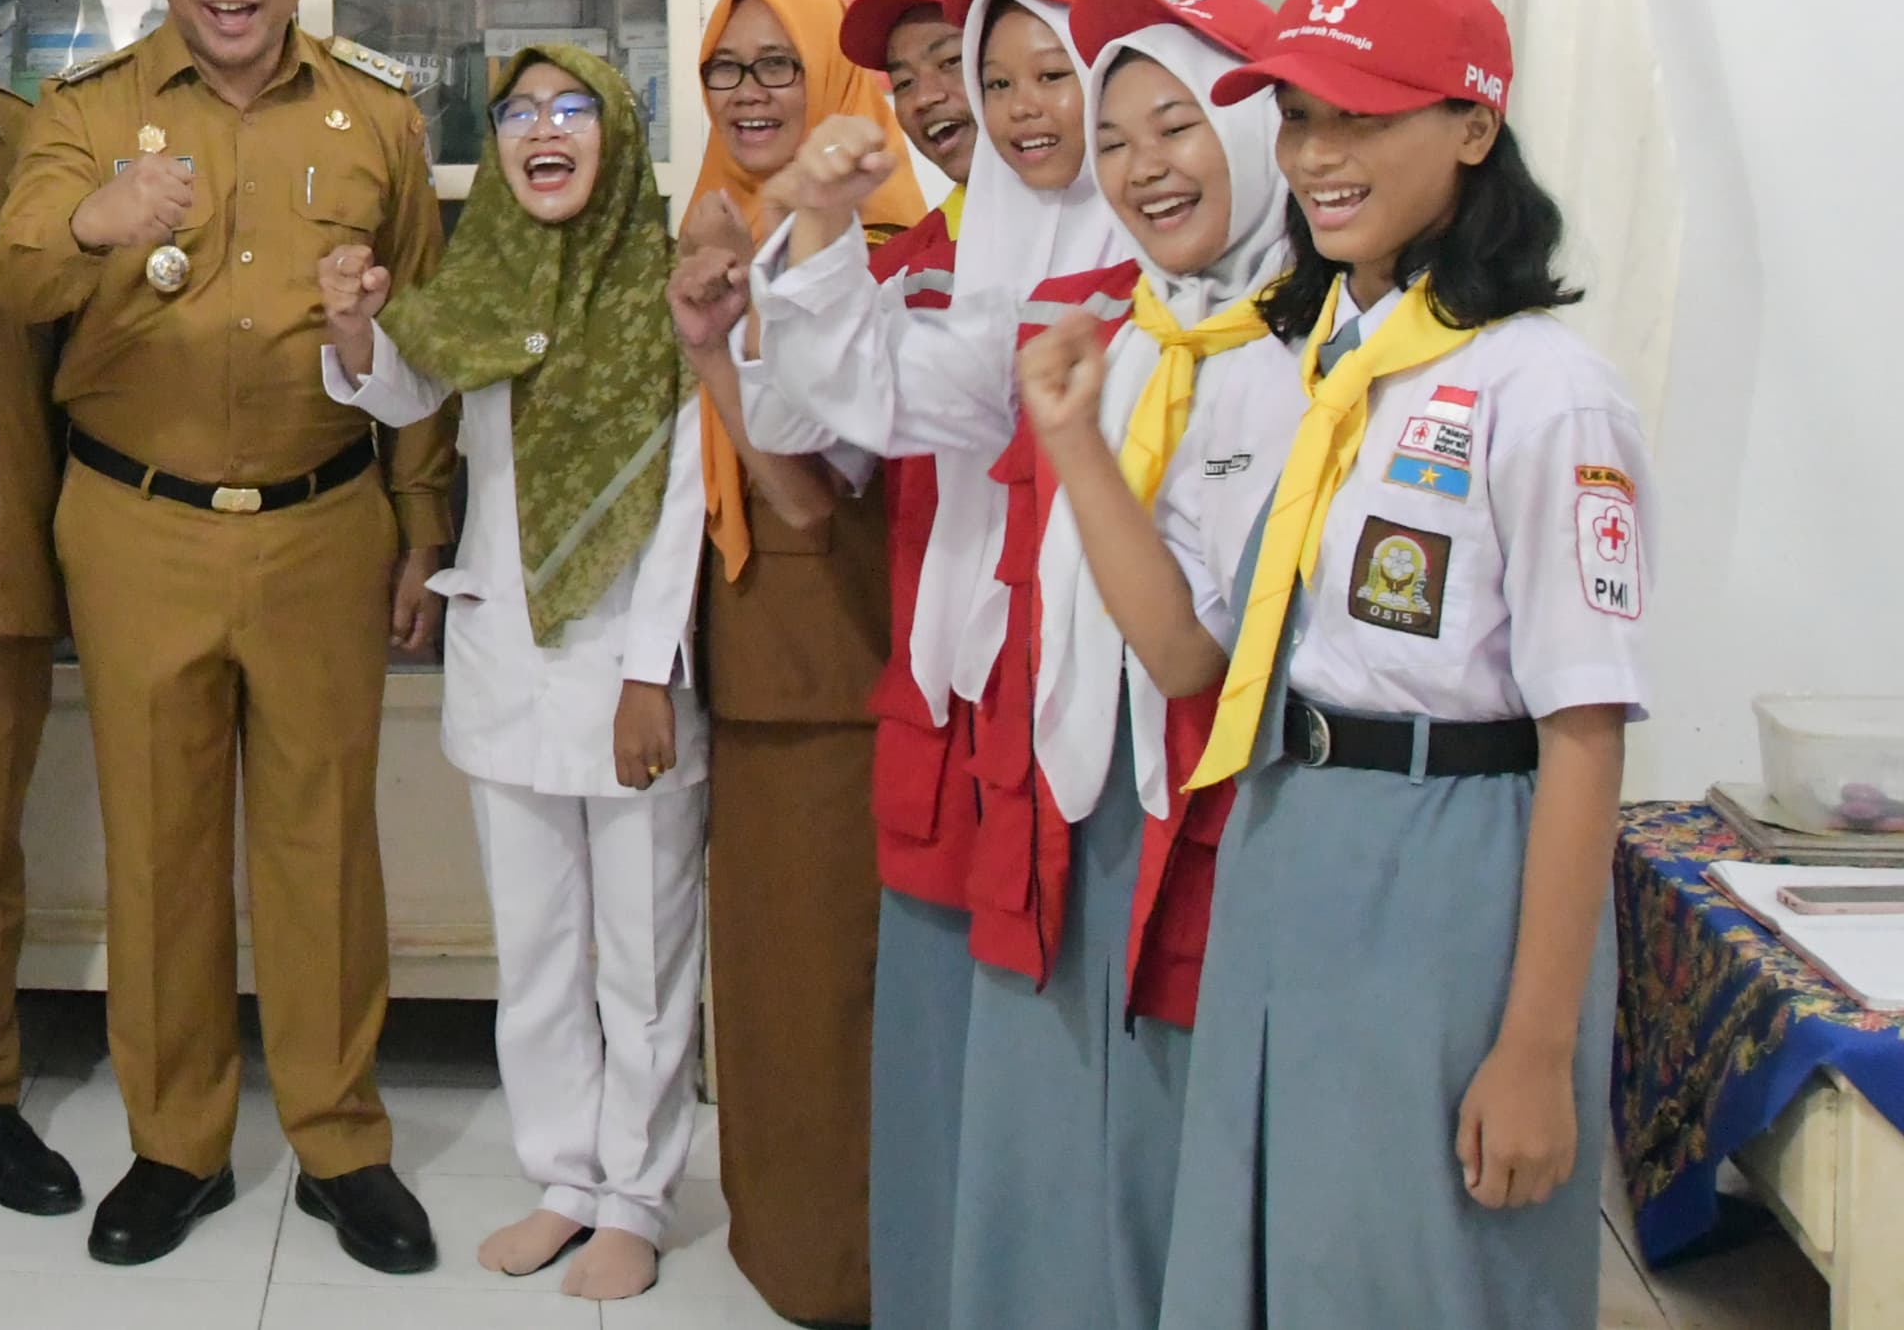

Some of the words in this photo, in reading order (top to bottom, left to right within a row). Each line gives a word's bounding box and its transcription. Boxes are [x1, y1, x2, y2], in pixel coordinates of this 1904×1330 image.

[1328, 28, 1373, 51] Remaja
[1464, 63, 1503, 104] PMR
[1595, 577, 1629, 611] PMI
[1369, 604, 1414, 625] OSIS
